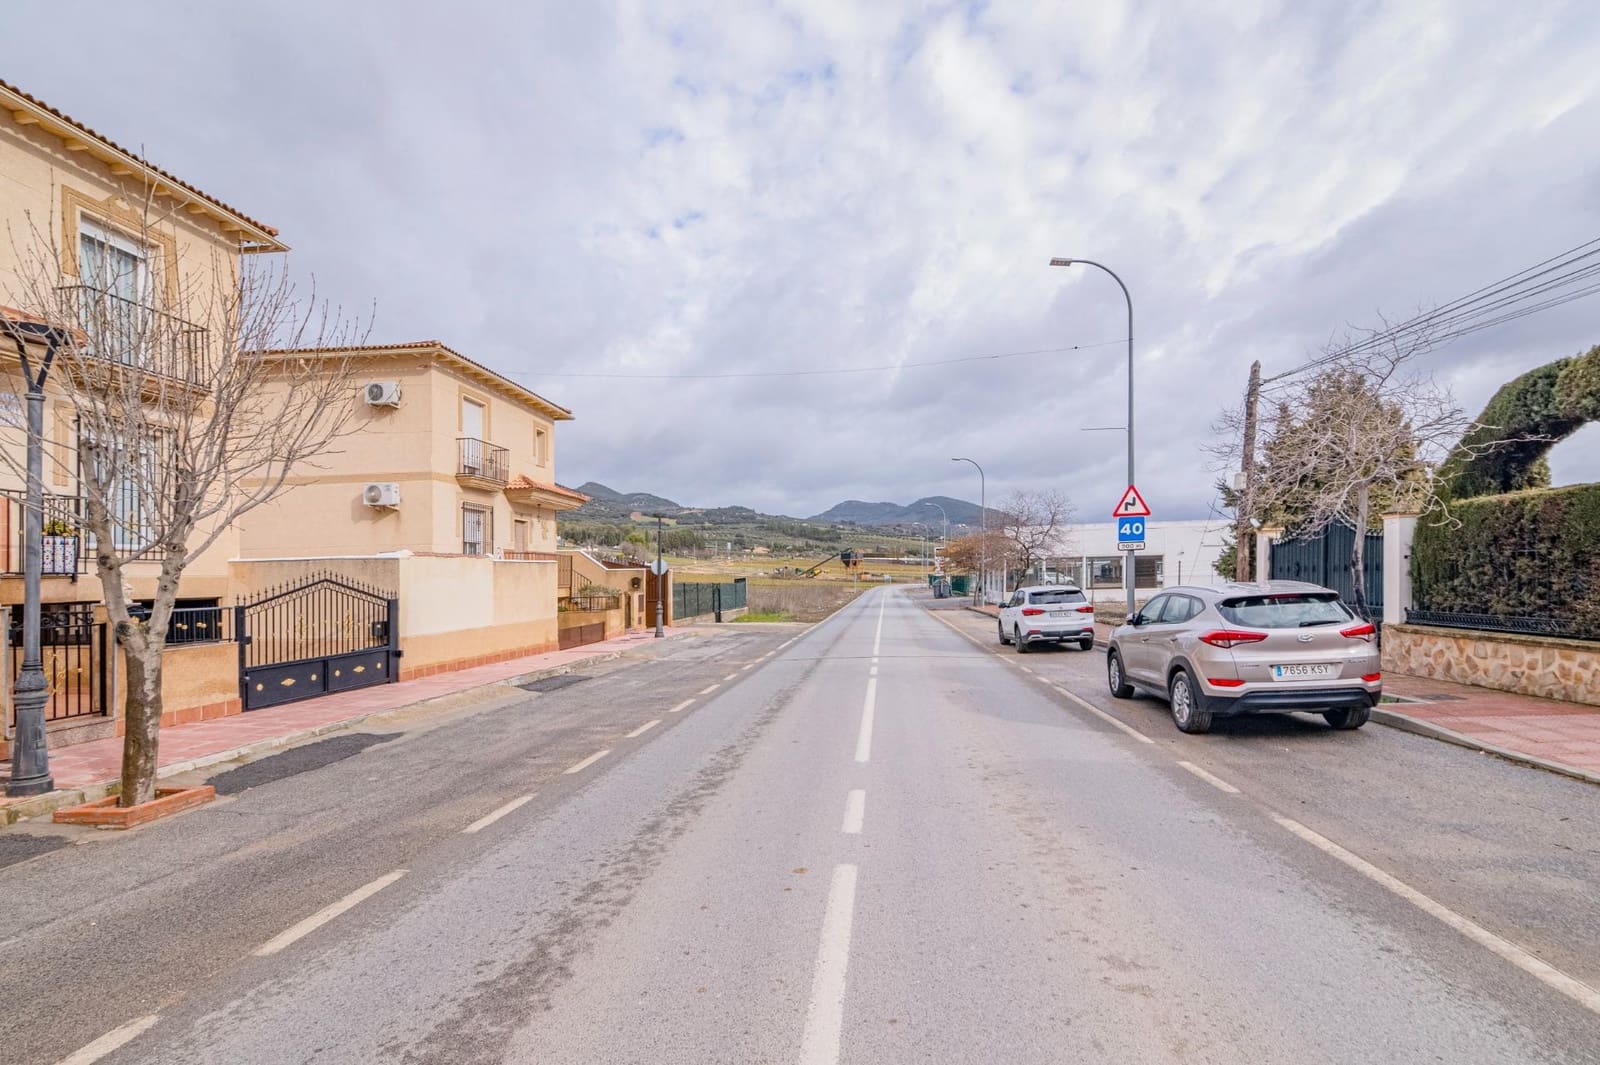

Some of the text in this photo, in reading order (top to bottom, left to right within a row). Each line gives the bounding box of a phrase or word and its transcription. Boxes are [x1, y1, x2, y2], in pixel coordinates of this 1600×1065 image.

[1120, 523, 1143, 535] 40
[1283, 664, 1329, 675] 7656 KSY
